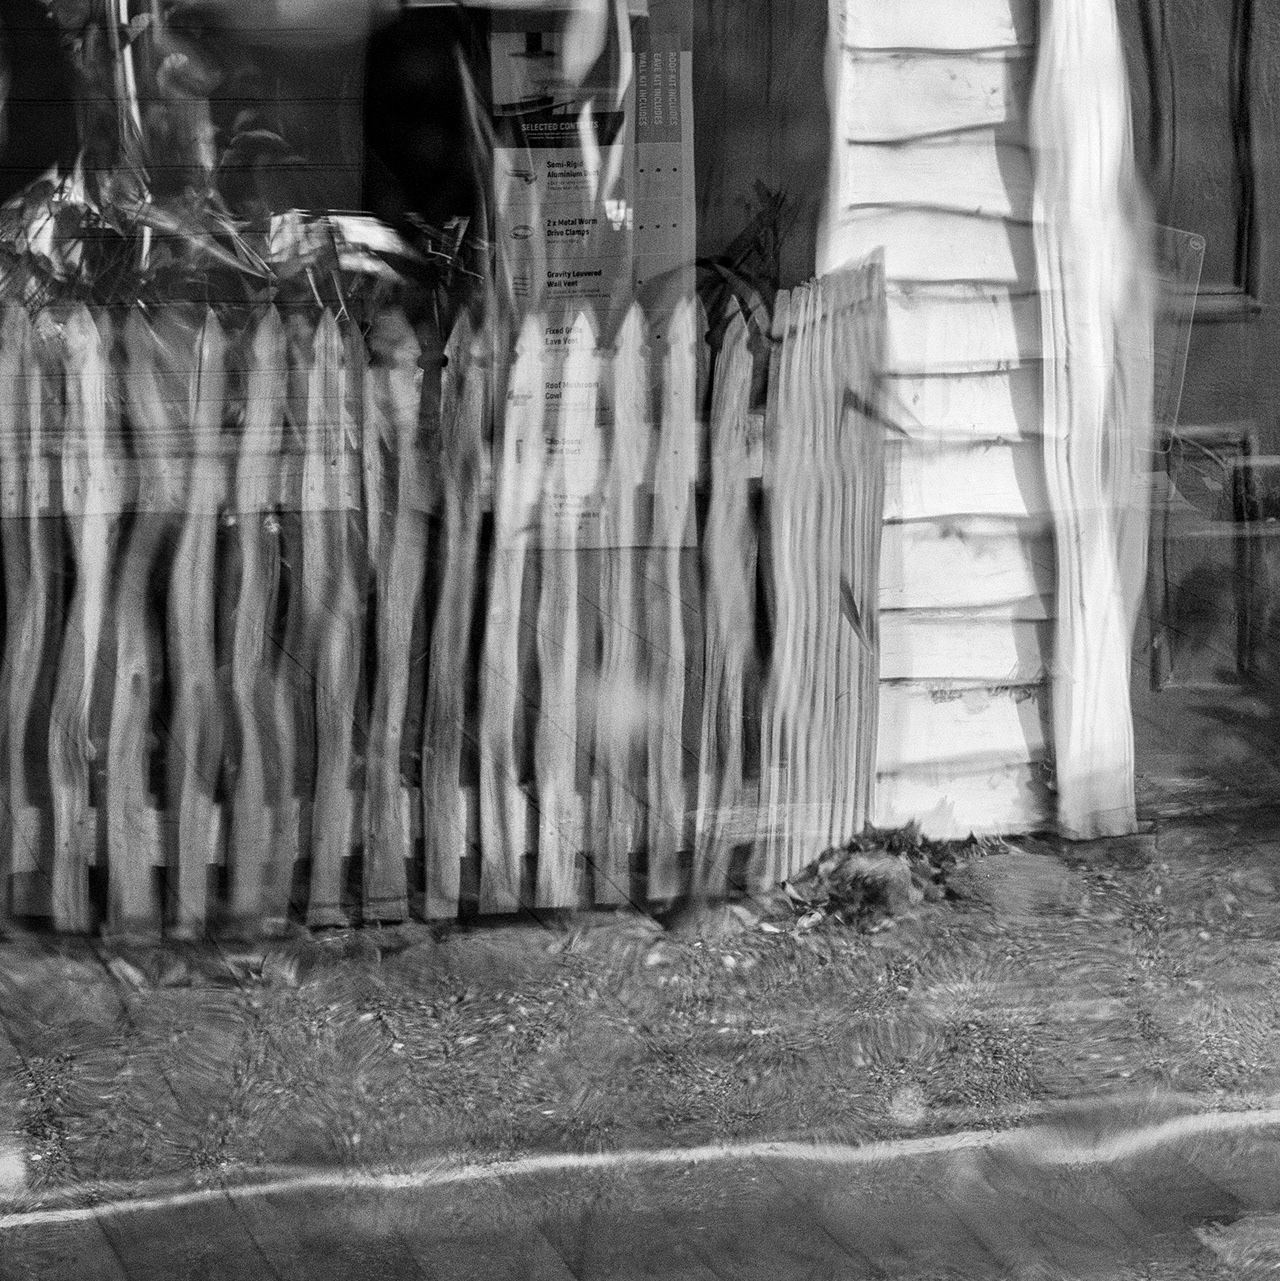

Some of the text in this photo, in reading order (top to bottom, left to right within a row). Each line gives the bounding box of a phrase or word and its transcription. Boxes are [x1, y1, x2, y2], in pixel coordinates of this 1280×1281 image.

[521, 122, 558, 132] SELECTED
[557, 217, 577, 227] Metal
[578, 217, 599, 226] Worm
[546, 228, 590, 239] Drive Clamps
[546, 269, 571, 279] Gravity
[546, 279, 579, 289] Wall Vent
[545, 381, 562, 390] Roof
